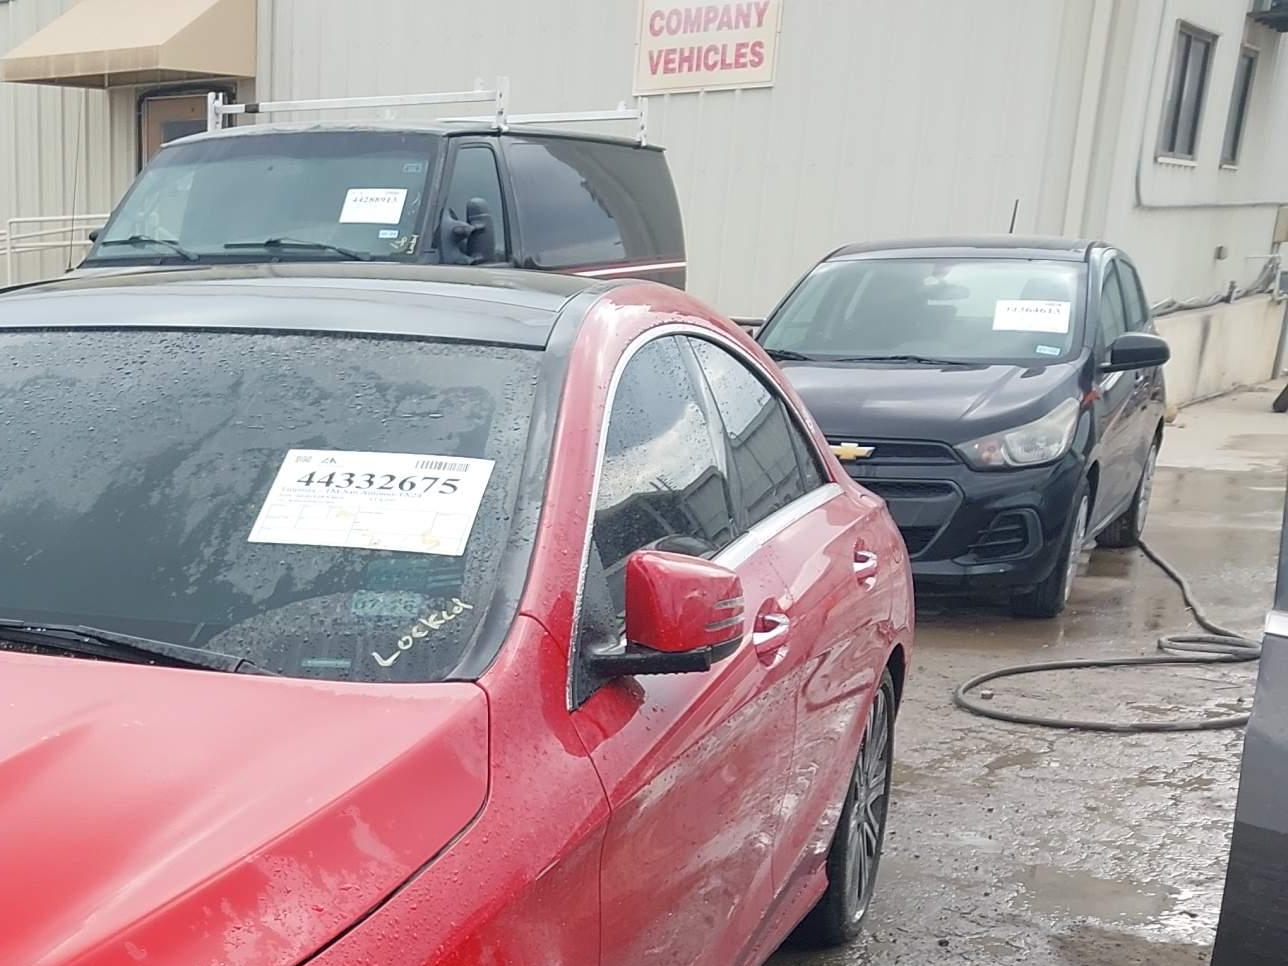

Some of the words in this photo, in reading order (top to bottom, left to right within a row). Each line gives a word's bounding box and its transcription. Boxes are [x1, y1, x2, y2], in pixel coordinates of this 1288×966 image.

[649, 0, 770, 37] COMPANY
[648, 40, 765, 76] VEHICLES
[296, 471, 462, 496] 44332675
